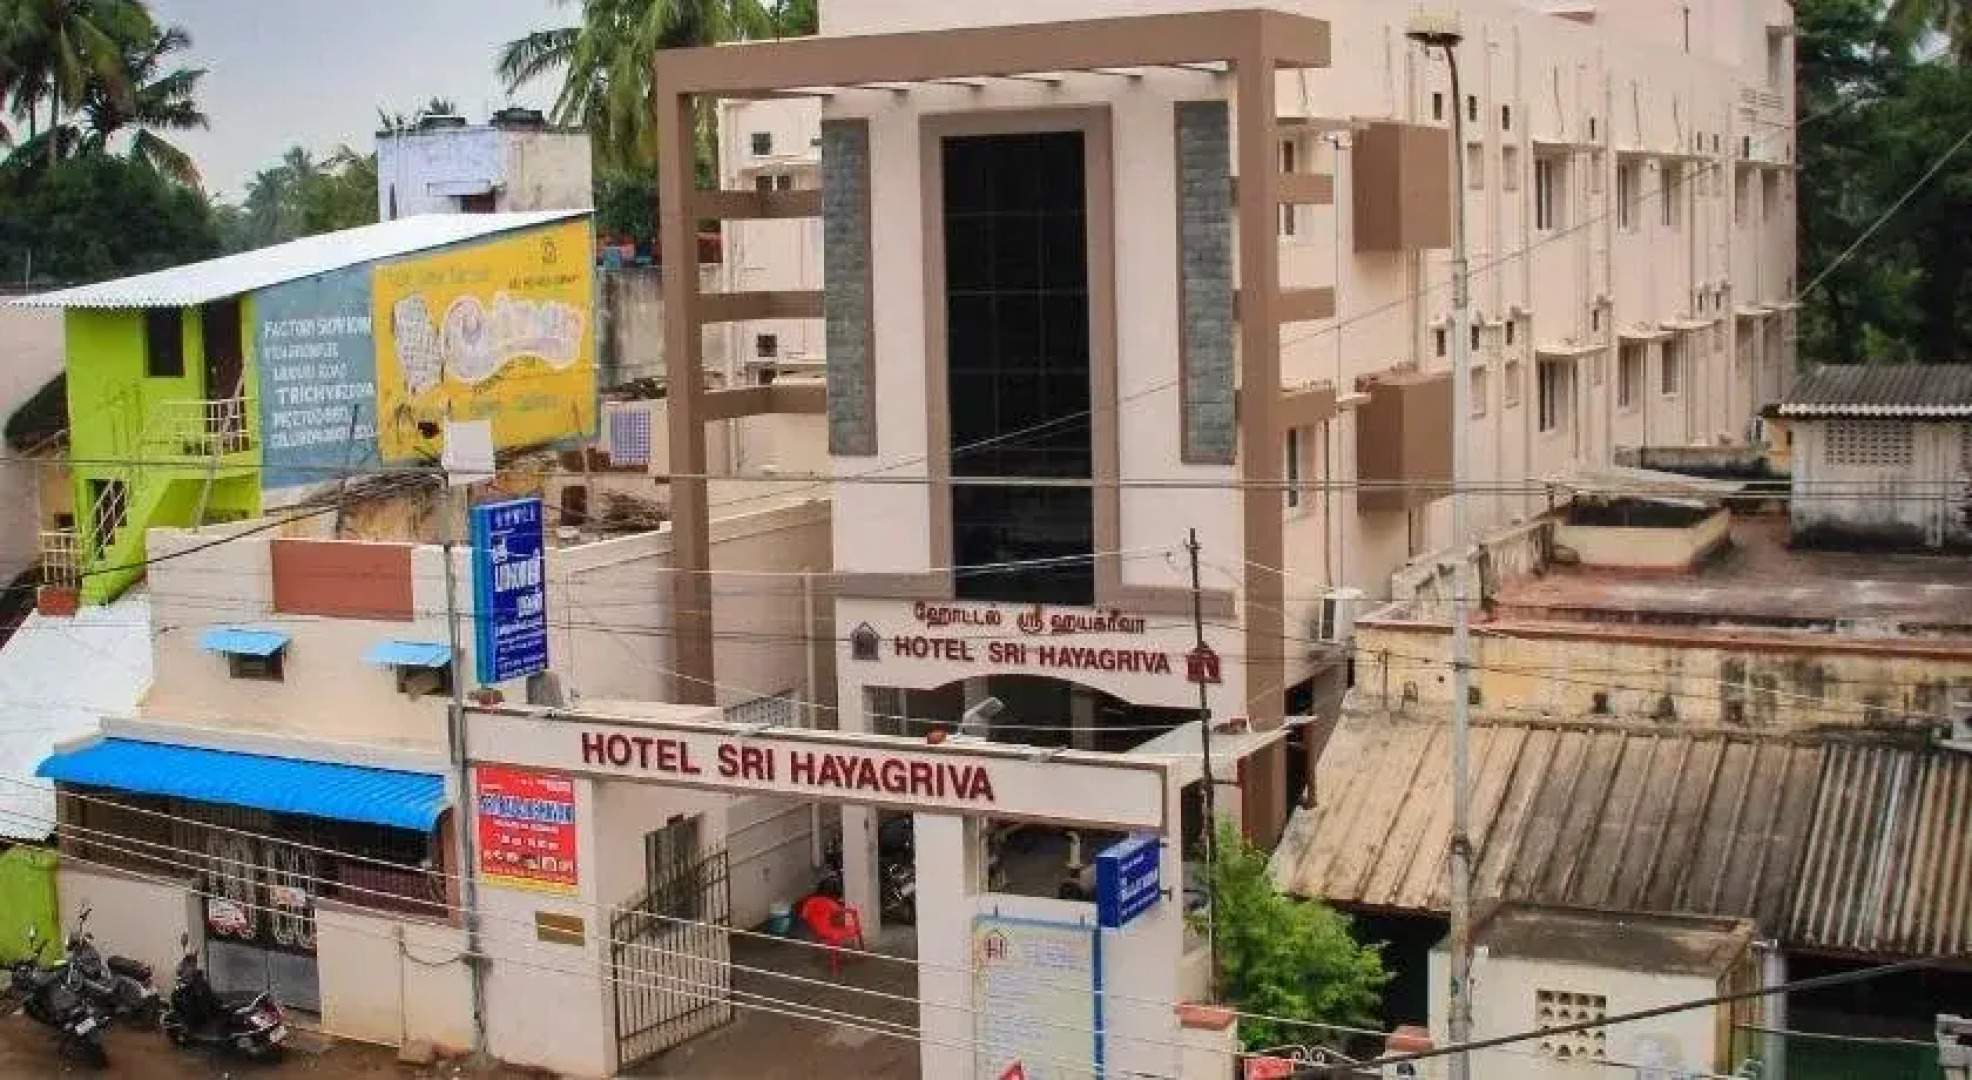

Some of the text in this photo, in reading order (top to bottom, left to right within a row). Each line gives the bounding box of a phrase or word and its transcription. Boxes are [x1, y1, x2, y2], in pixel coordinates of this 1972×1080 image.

[913, 601, 1002, 628] ஹோட்டல்
[894, 636, 1171, 674] HOTEL SRI HAYAGRIVA
[581, 731, 995, 800] HOTEL SRI HAYAGRIVA
